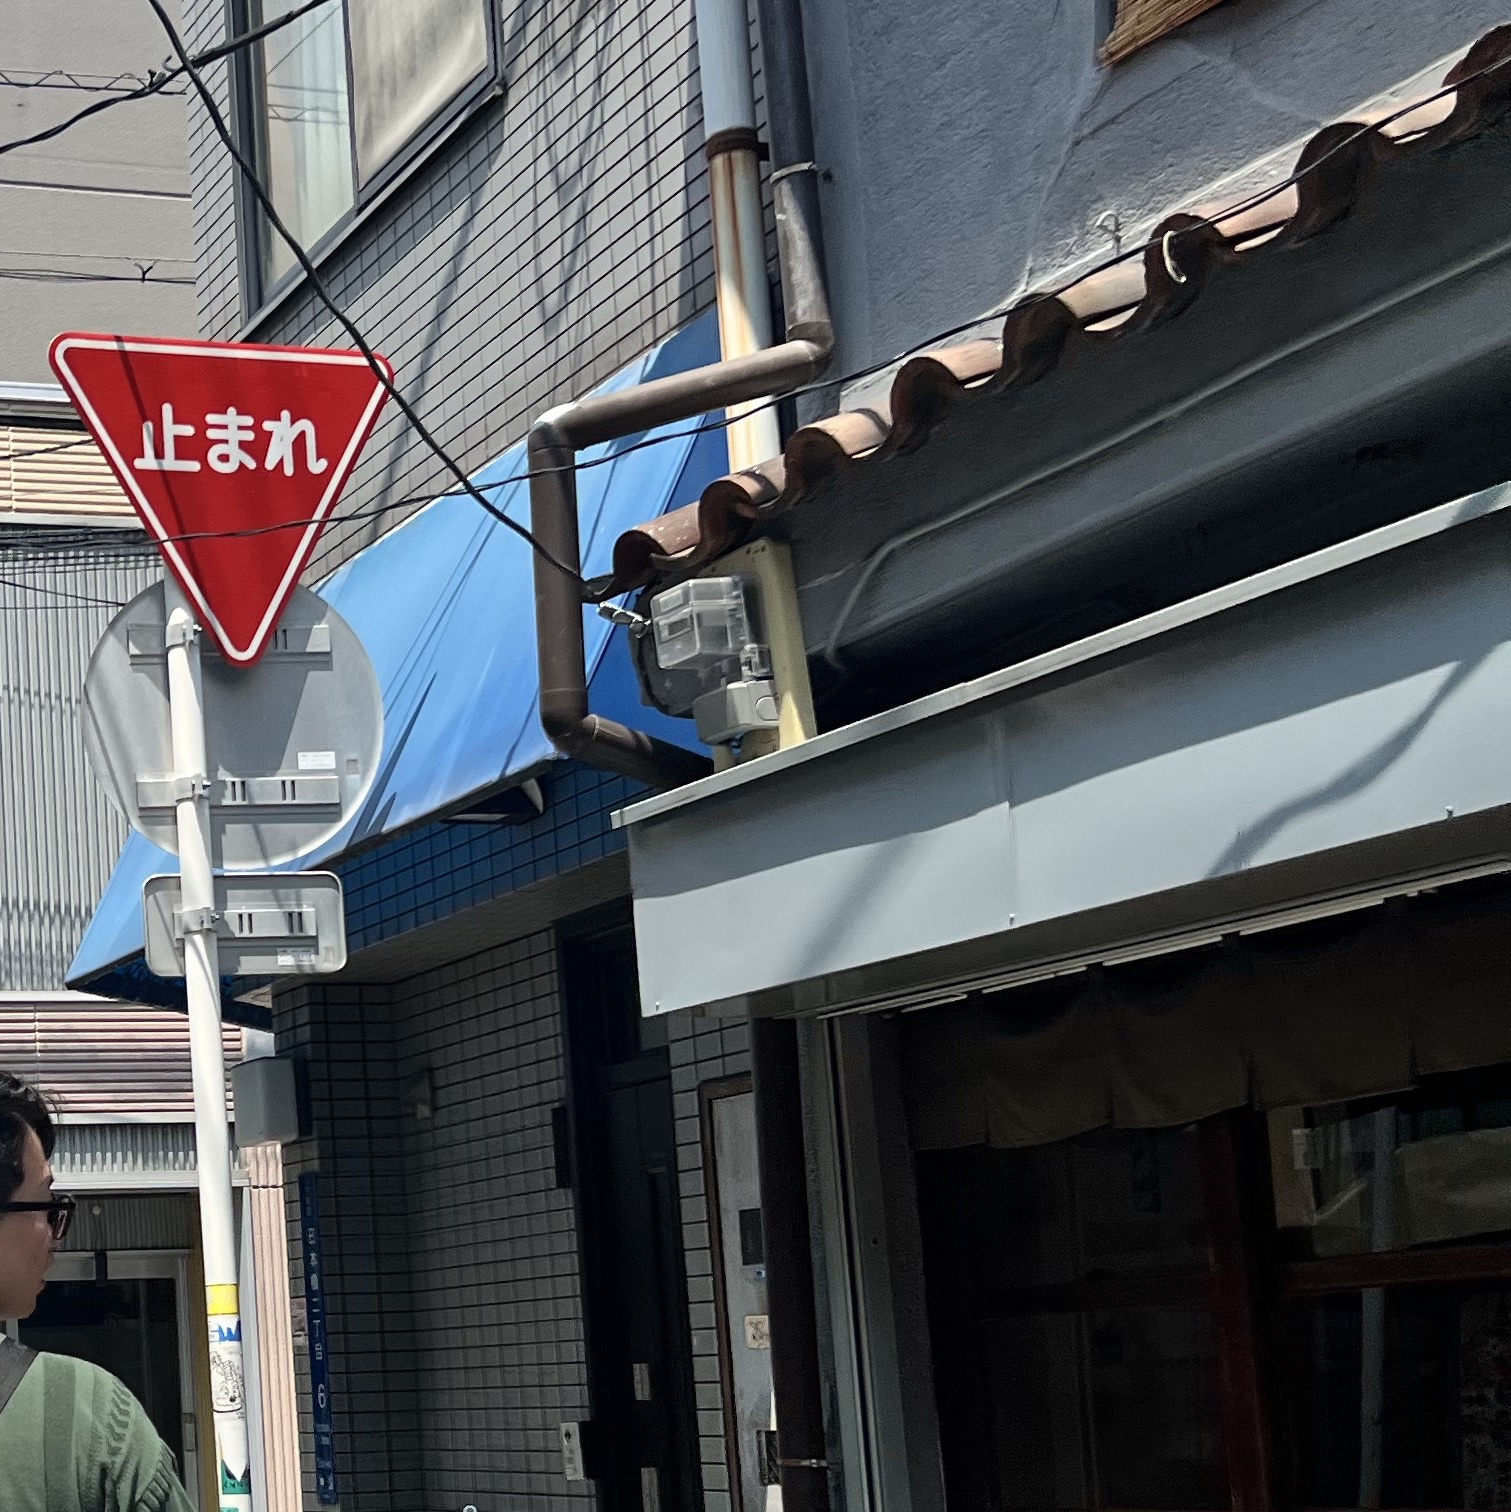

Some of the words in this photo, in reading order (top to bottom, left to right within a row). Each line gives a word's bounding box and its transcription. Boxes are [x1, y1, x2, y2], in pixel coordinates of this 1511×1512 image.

[133, 402, 329, 476] 止まれ
[317, 1383, 327, 1409] 6
